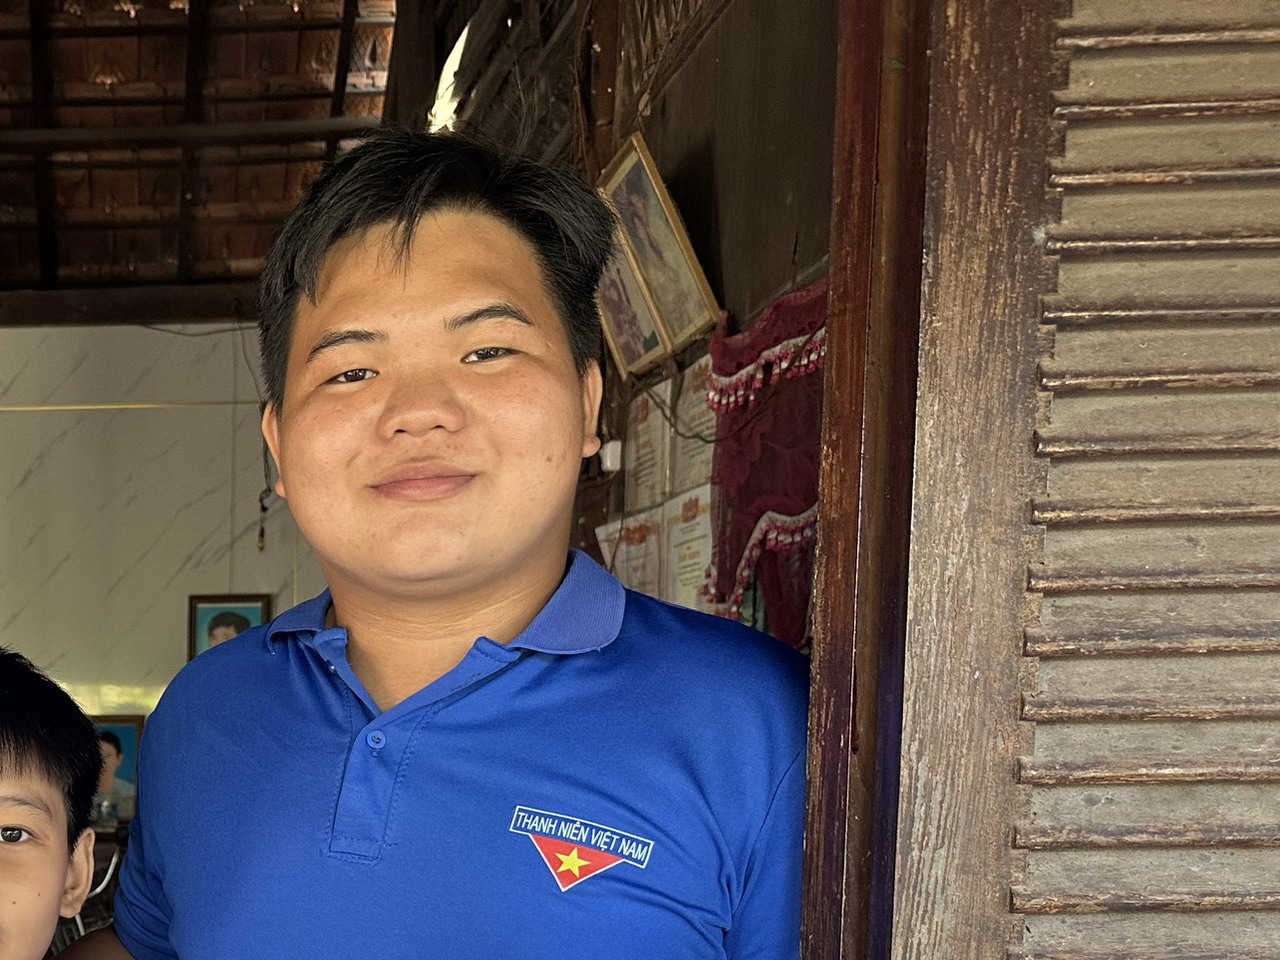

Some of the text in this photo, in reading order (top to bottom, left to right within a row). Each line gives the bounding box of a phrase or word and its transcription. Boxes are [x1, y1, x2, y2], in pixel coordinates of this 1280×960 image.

[516, 812, 648, 861] THANH NIÊN VIỆT NAM
